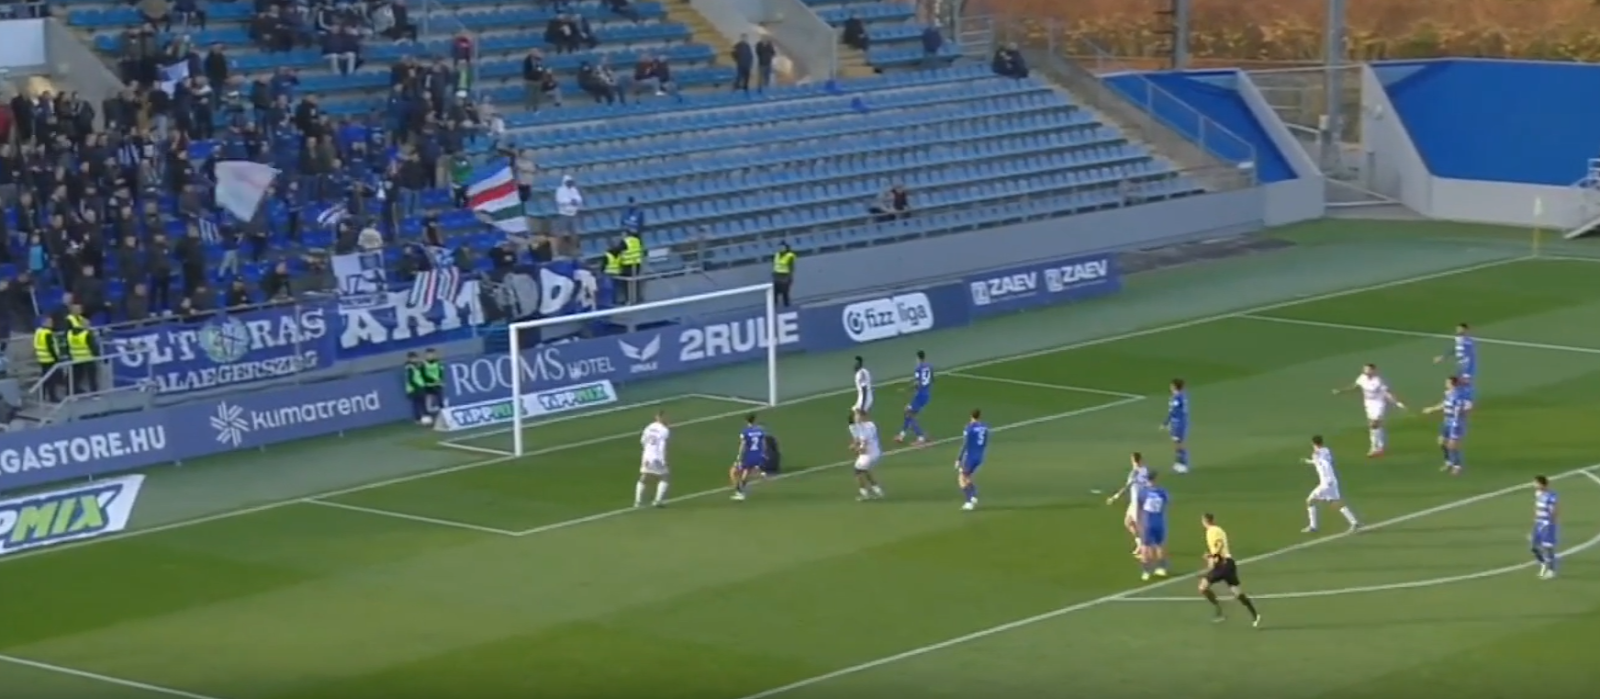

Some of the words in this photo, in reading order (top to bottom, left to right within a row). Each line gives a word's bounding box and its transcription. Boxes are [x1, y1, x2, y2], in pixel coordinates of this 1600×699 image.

[988, 271, 1037, 296] ZAEV
[1061, 259, 1107, 283] ZAEV
[679, 311, 799, 361] 2RULE
[865, 308, 895, 329] fizz
[450, 347, 566, 396] ROOMS
[567, 356, 616, 380] HOTEL
[0, 425, 166, 475] GASTORE.HU
